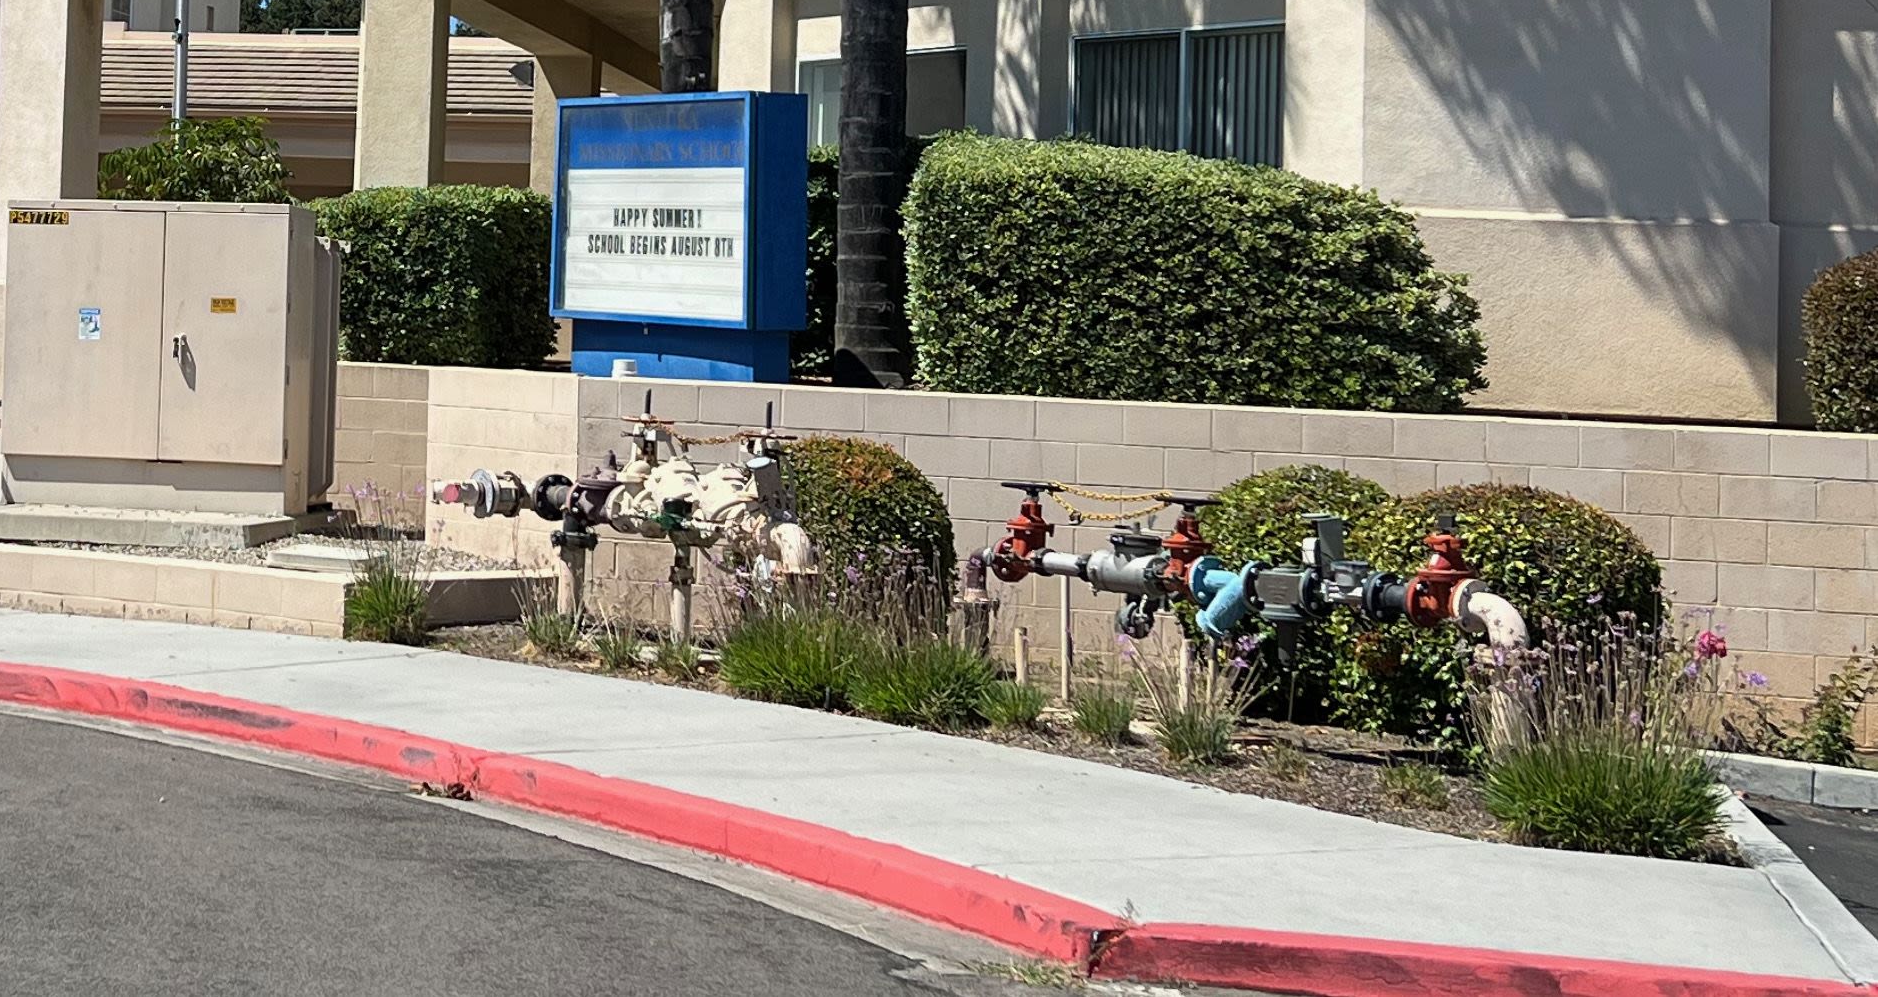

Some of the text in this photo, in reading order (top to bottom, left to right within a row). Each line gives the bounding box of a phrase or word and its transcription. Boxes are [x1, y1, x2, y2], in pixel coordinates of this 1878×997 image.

[613, 208, 702, 229] HAPPY SUMMER!
[587, 234, 734, 257] SCHOOL BEGINS AUGUST 8TH
